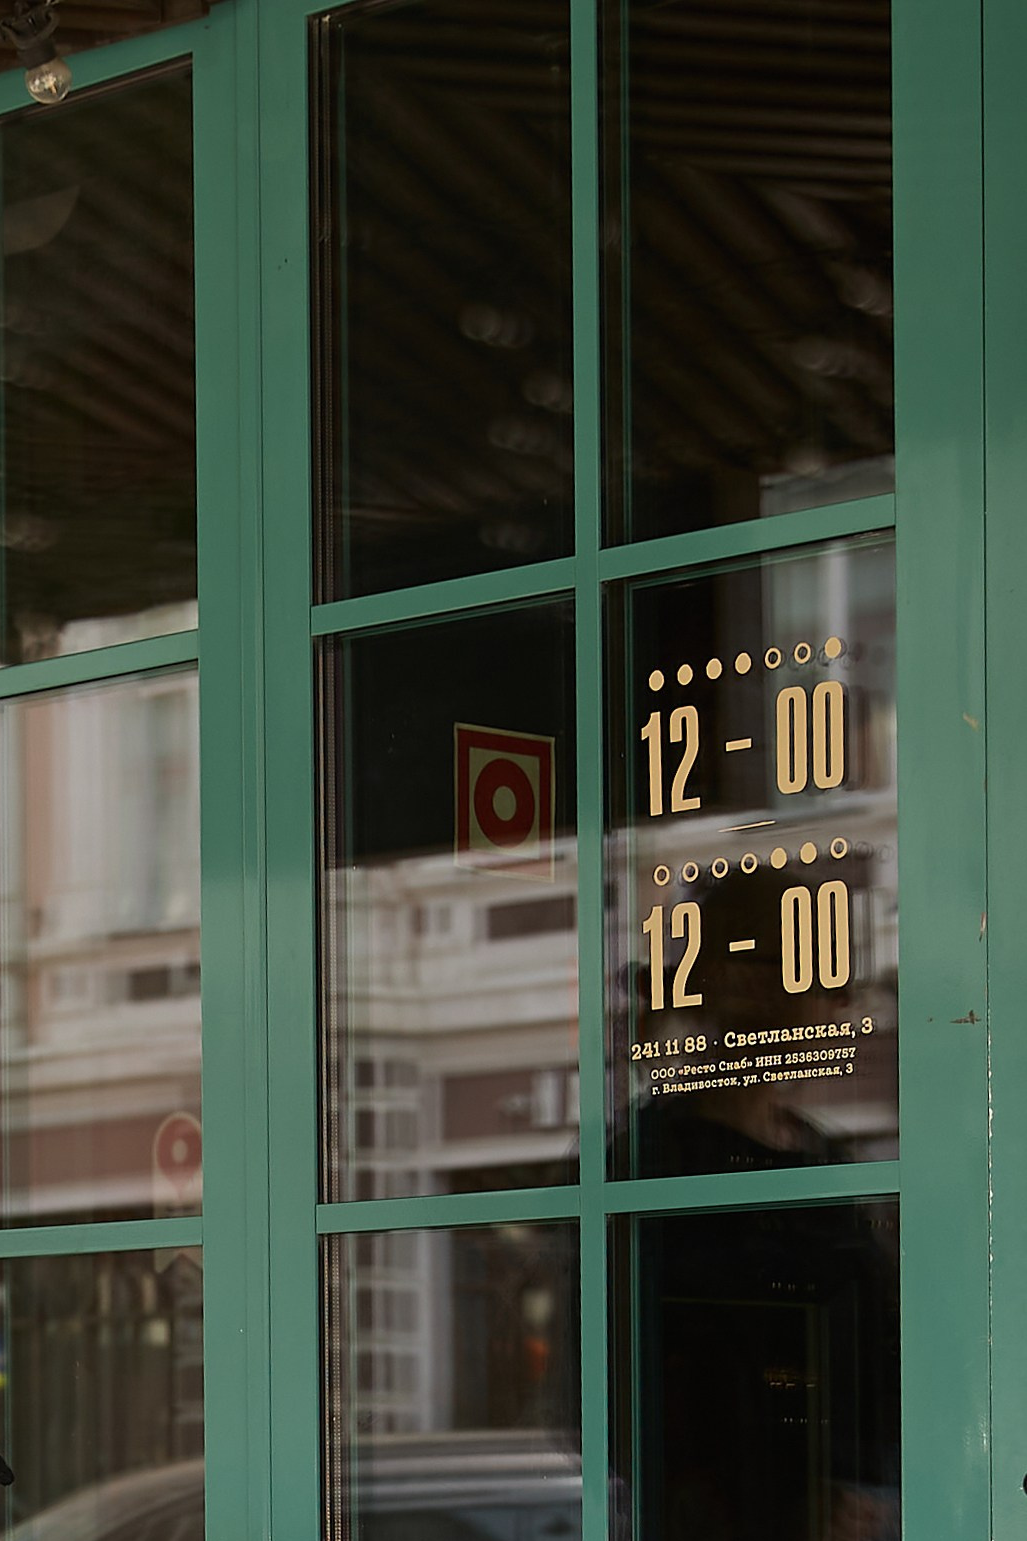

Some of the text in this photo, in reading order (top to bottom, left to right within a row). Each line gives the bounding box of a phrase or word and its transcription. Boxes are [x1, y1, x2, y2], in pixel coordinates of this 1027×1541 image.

[641, 705, 701, 816] 12
[776, 680, 844, 795] 00
[642, 901, 703, 1010] 12
[781, 880, 850, 994] 00
[631, 1041, 661, 1061] 241
[664, 1038, 680, 1056] 11
[684, 1035, 707, 1053] 88
[723, 1022, 856, 1049] Светланская,
[861, 1016, 873, 1034] 3
[651, 1046, 856, 1080] ООО «Ресто Снаб» ИНН 2536309757
[652, 1062, 854, 1096] г. Владивосток, ул. Светланская, 3
